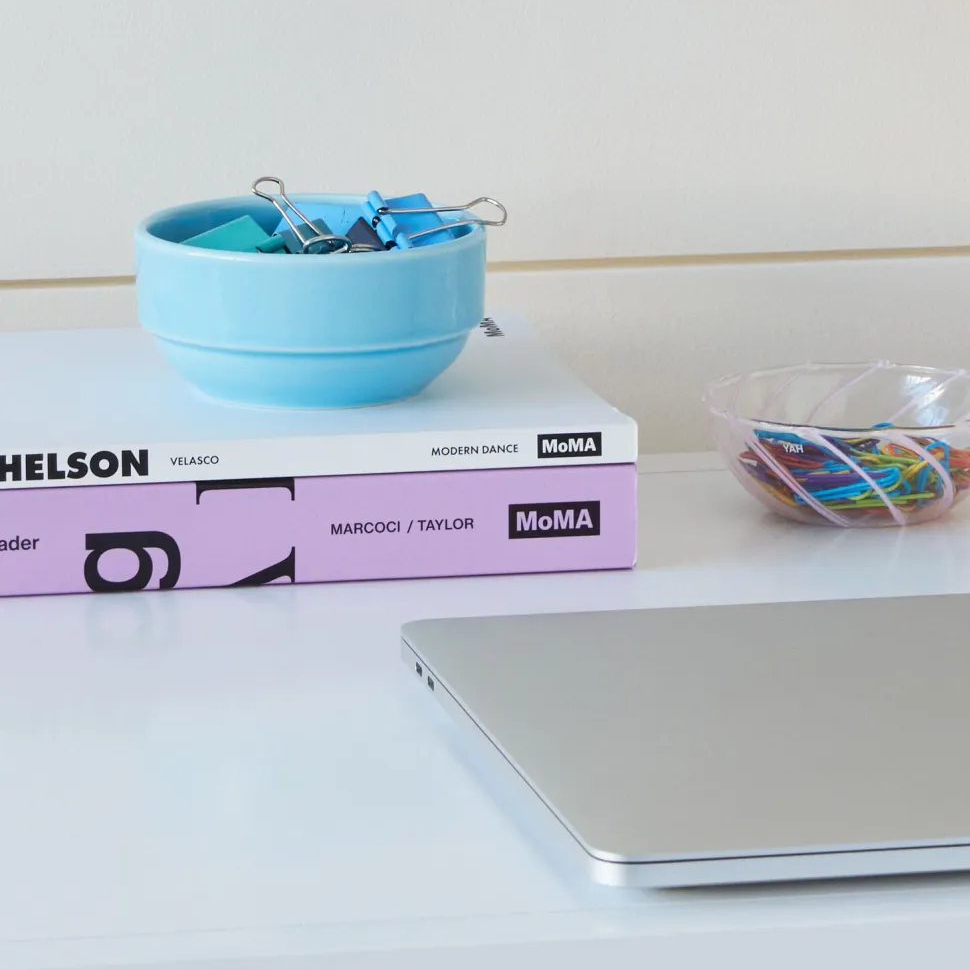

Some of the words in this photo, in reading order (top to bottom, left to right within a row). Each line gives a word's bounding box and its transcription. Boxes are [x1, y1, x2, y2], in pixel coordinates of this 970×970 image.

[431, 445, 479, 457] MODERN
[481, 443, 519, 454] DANCE
[541, 436, 597, 454] MoMA
[0, 449, 149, 481] HELSON
[169, 455, 220, 466] VELASCO
[330, 520, 401, 536] MARCOCI
[417, 517, 475, 532] TAYLOR
[515, 507, 594, 532] MoMA
